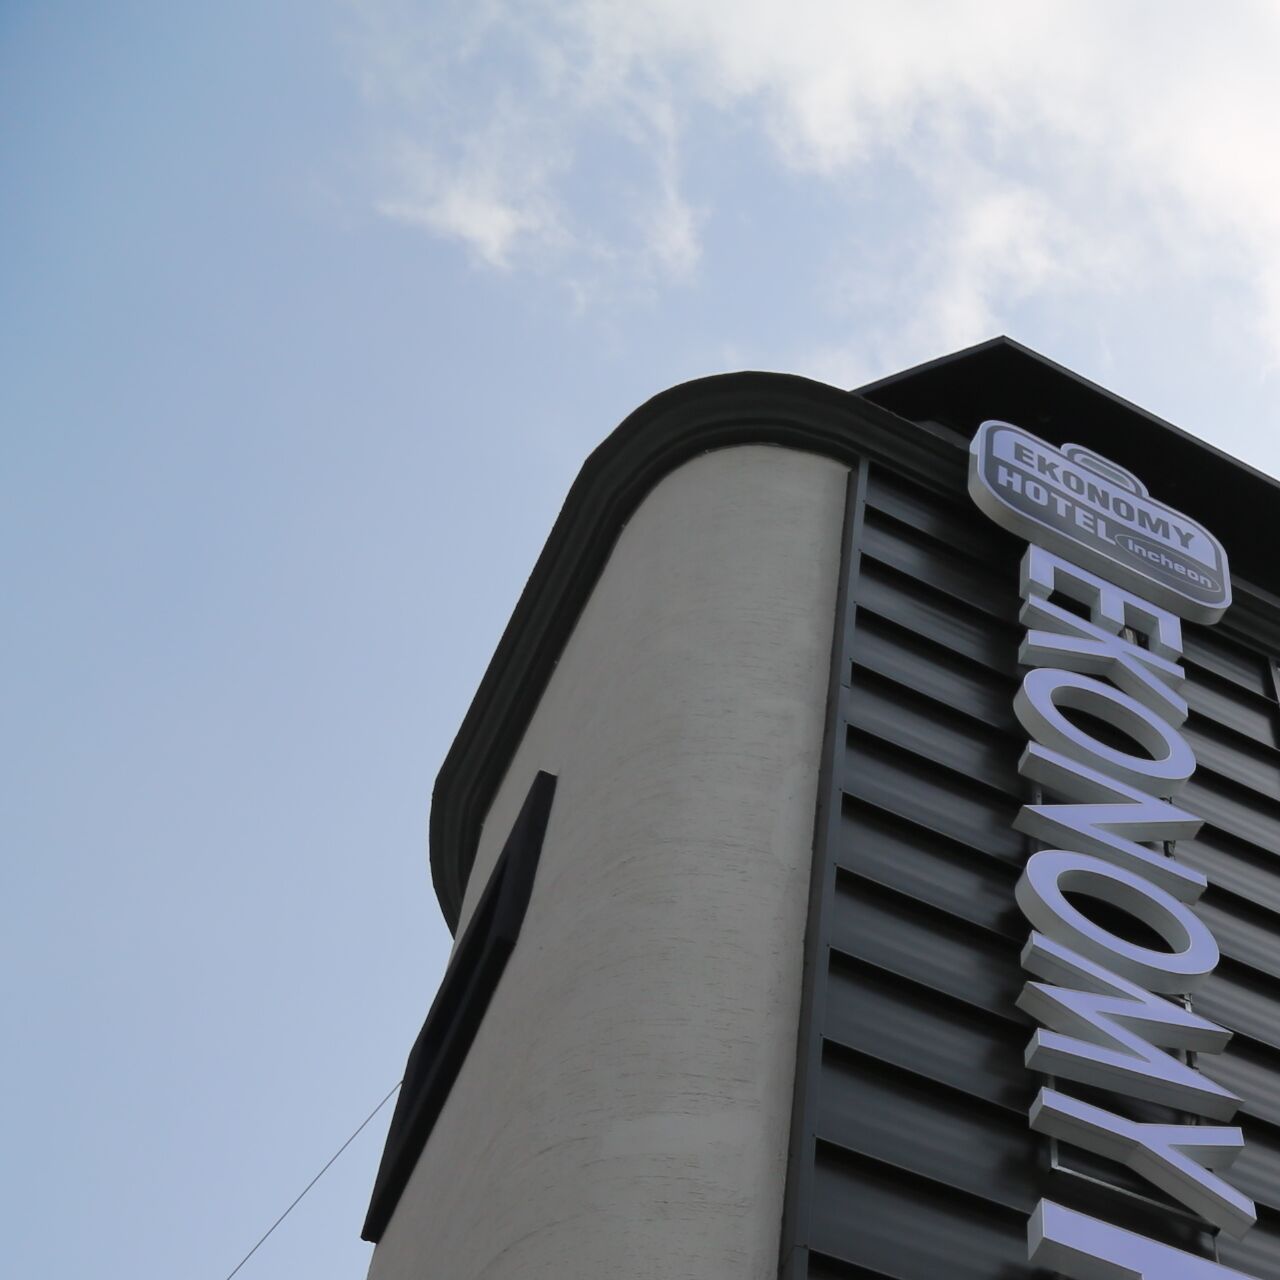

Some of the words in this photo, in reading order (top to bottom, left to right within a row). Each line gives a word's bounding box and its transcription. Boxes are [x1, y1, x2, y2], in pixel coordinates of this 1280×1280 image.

[997, 465, 1117, 546] HOTEL
[1013, 440, 1197, 550] EKONOMY
[1127, 537, 1213, 589] Incheon
[1020, 542, 1257, 1224] EKONOMY
